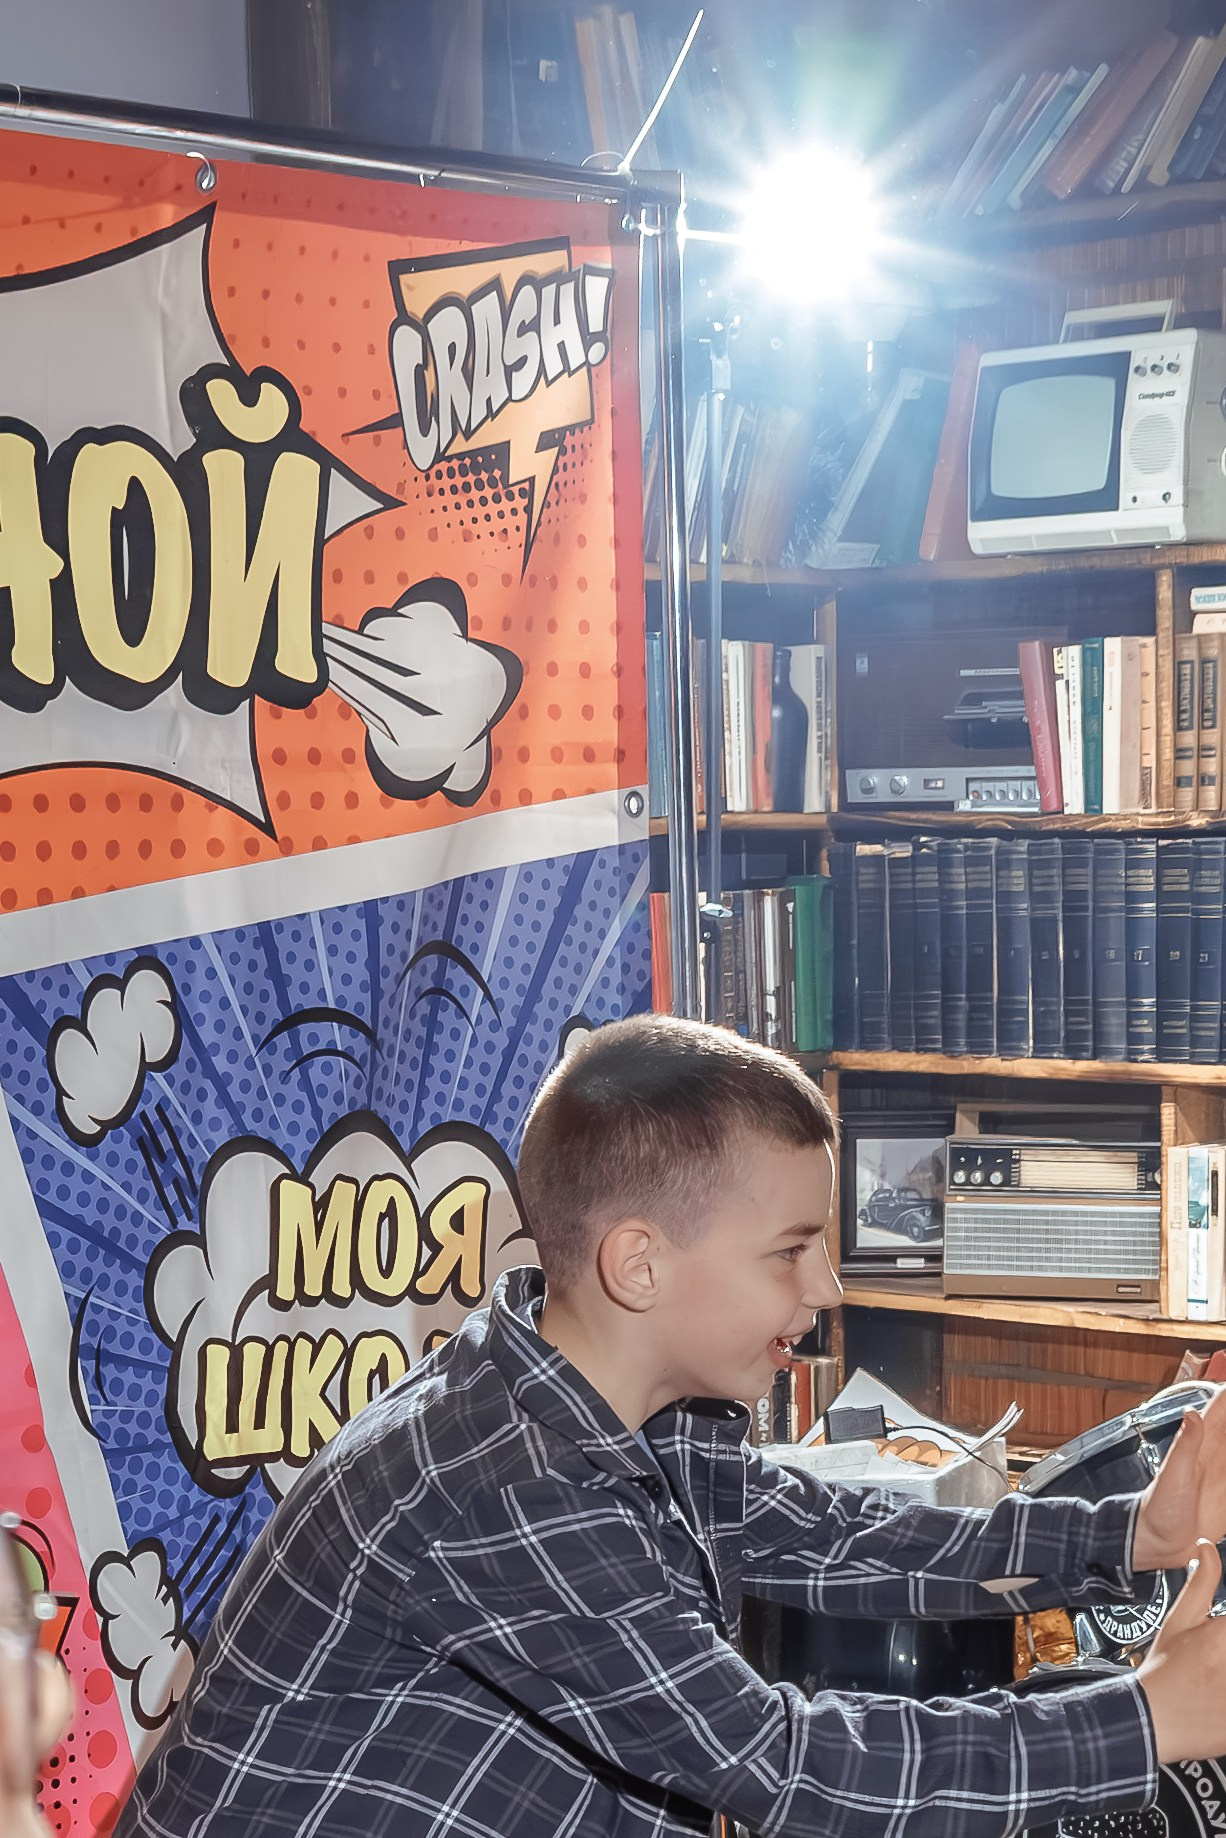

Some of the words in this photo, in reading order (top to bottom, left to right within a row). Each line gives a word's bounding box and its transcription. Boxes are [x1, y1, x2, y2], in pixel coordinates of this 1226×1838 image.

[393, 263, 616, 470] CRASH!
[273, 1178, 486, 1301] МОЯ
[200, 1334, 440, 1463] ШКО
